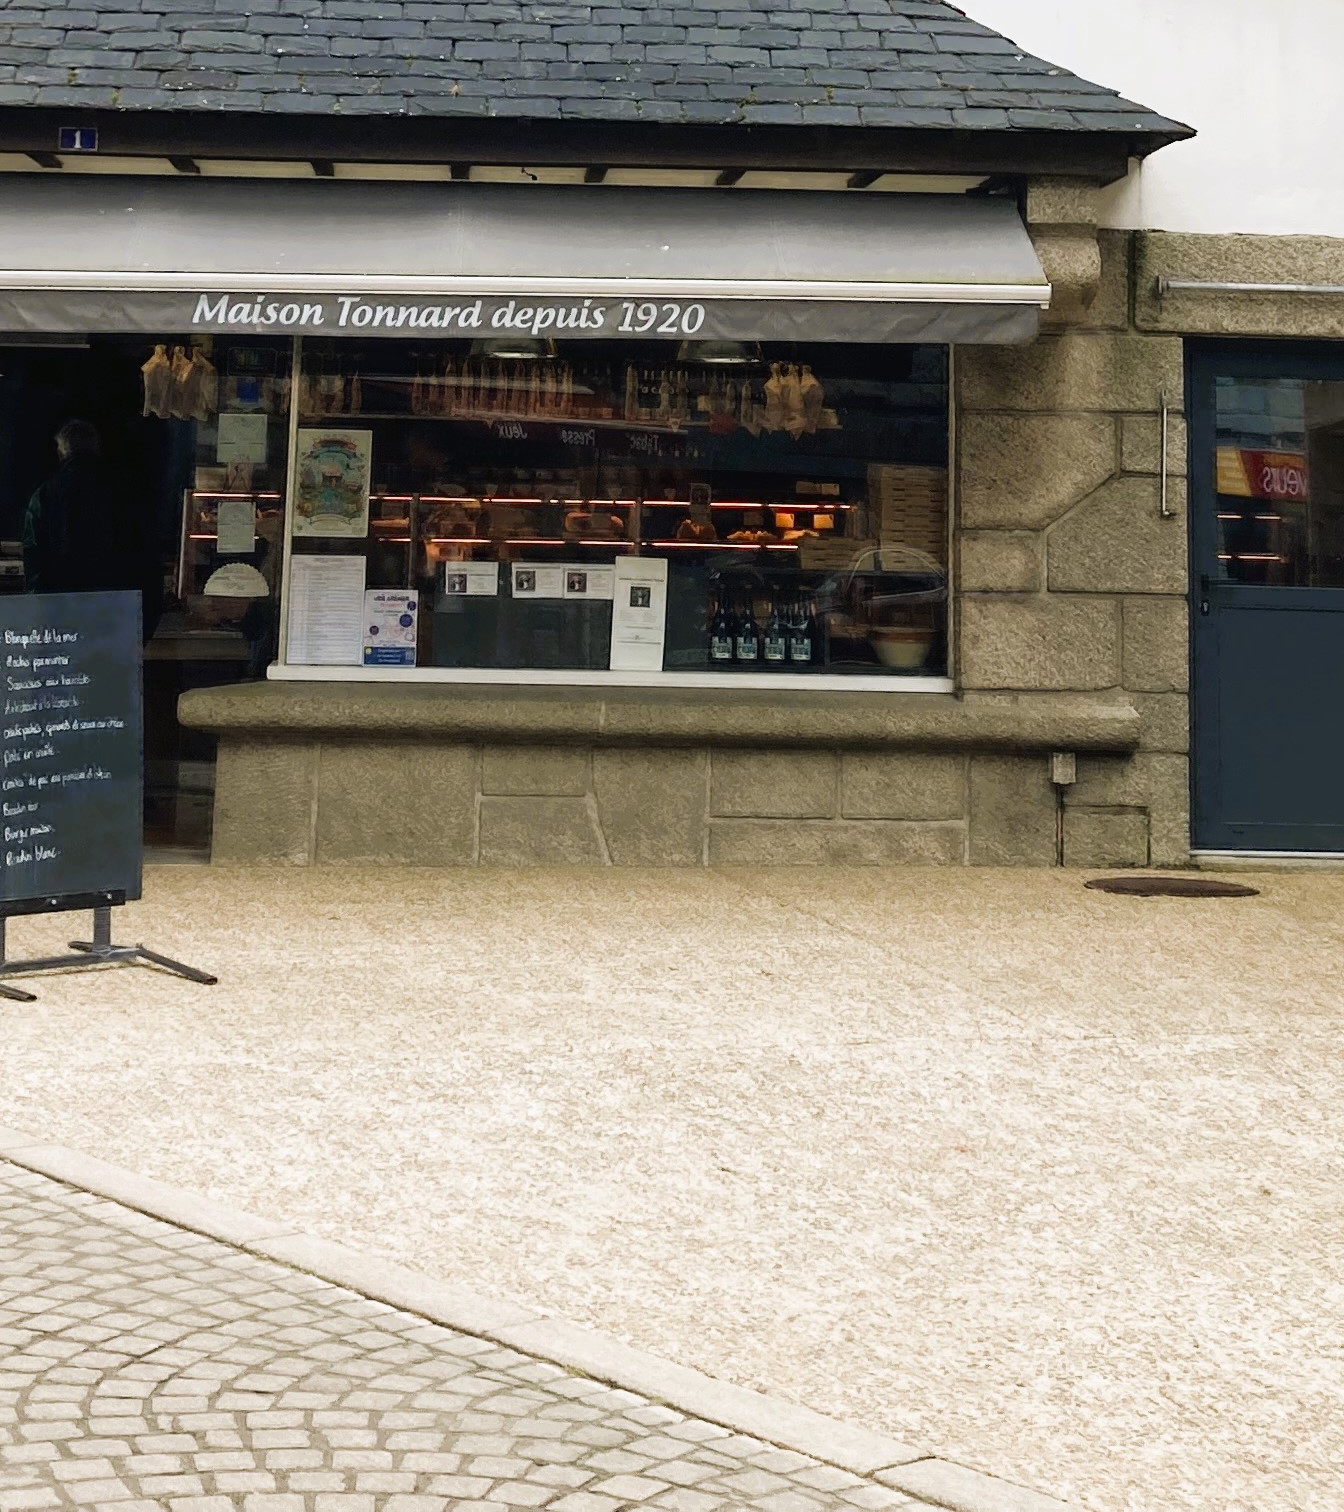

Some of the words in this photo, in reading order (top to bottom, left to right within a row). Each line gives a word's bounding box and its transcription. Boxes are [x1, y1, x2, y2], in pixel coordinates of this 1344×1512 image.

[73, 130, 82, 149] 1
[192, 293, 325, 327] Maison
[337, 295, 482, 329] Tonnard
[490, 299, 606, 334] depuis
[618, 301, 705, 334] 1920
